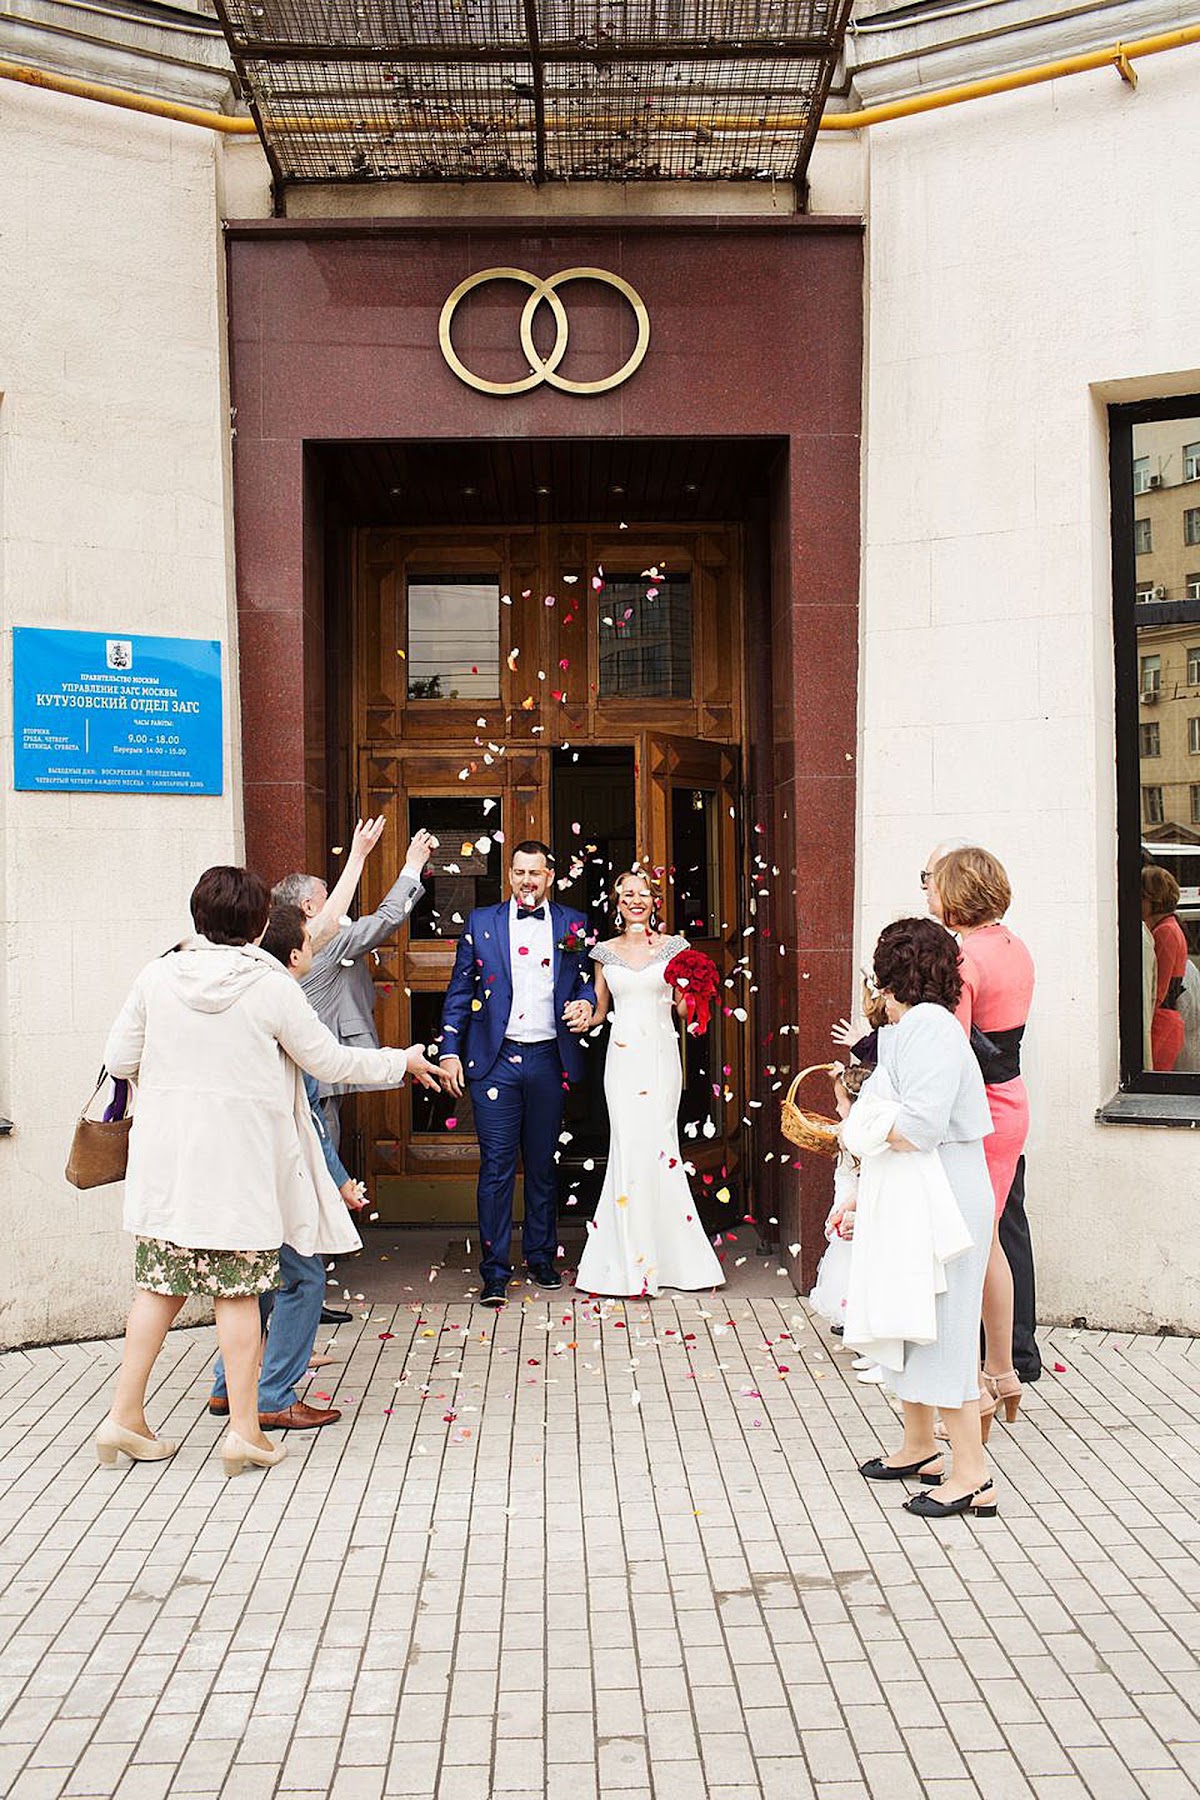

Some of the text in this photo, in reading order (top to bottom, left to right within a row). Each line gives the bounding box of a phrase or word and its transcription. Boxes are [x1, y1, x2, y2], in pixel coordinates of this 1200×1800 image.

[80, 674, 132, 683] ПРАВИТЕЛЬСТВО
[62, 683, 178, 697] УПРАВЛЕНИЕ ЗАГС МОСКВЫ
[36, 694, 200, 713] КУТУЗОВСКИЙ ОТДЕЛ ЗАГС
[128, 734, 148, 743] 9.00
[156, 735, 180, 744] 18.00
[113, 746, 142, 754] Перерыв
